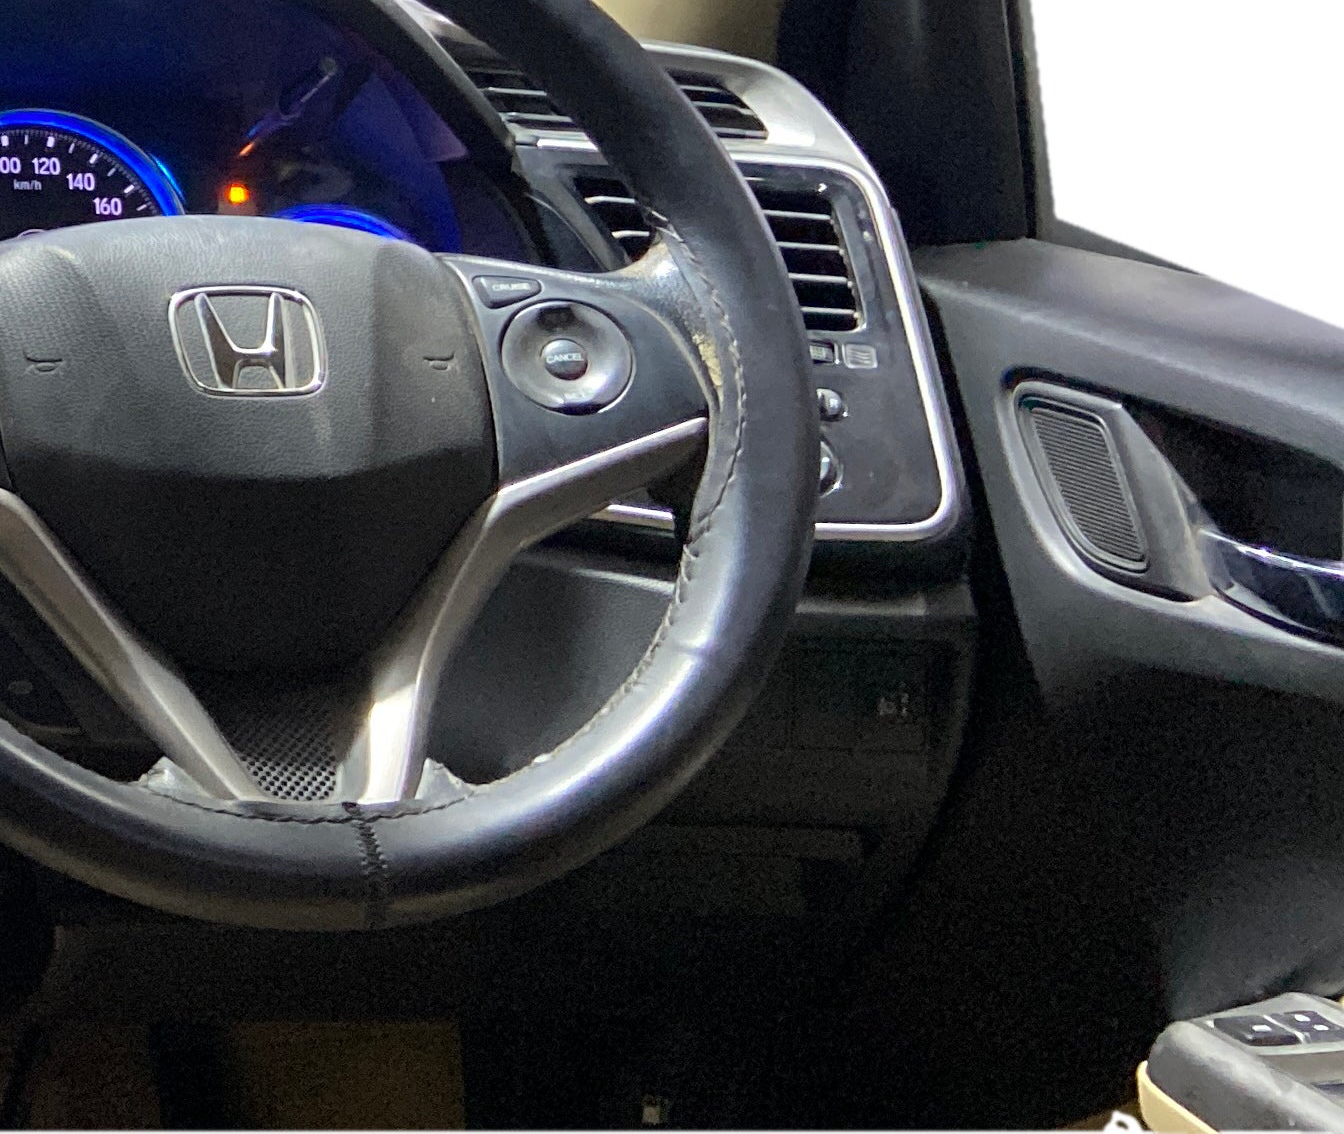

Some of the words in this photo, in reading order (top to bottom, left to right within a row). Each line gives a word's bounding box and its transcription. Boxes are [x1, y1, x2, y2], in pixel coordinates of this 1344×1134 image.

[32, 157, 61, 175] 120
[13, 180, 42, 191] km/h
[66, 173, 95, 191] 140
[93, 197, 122, 216] 160
[546, 353, 585, 364] CANCEL
